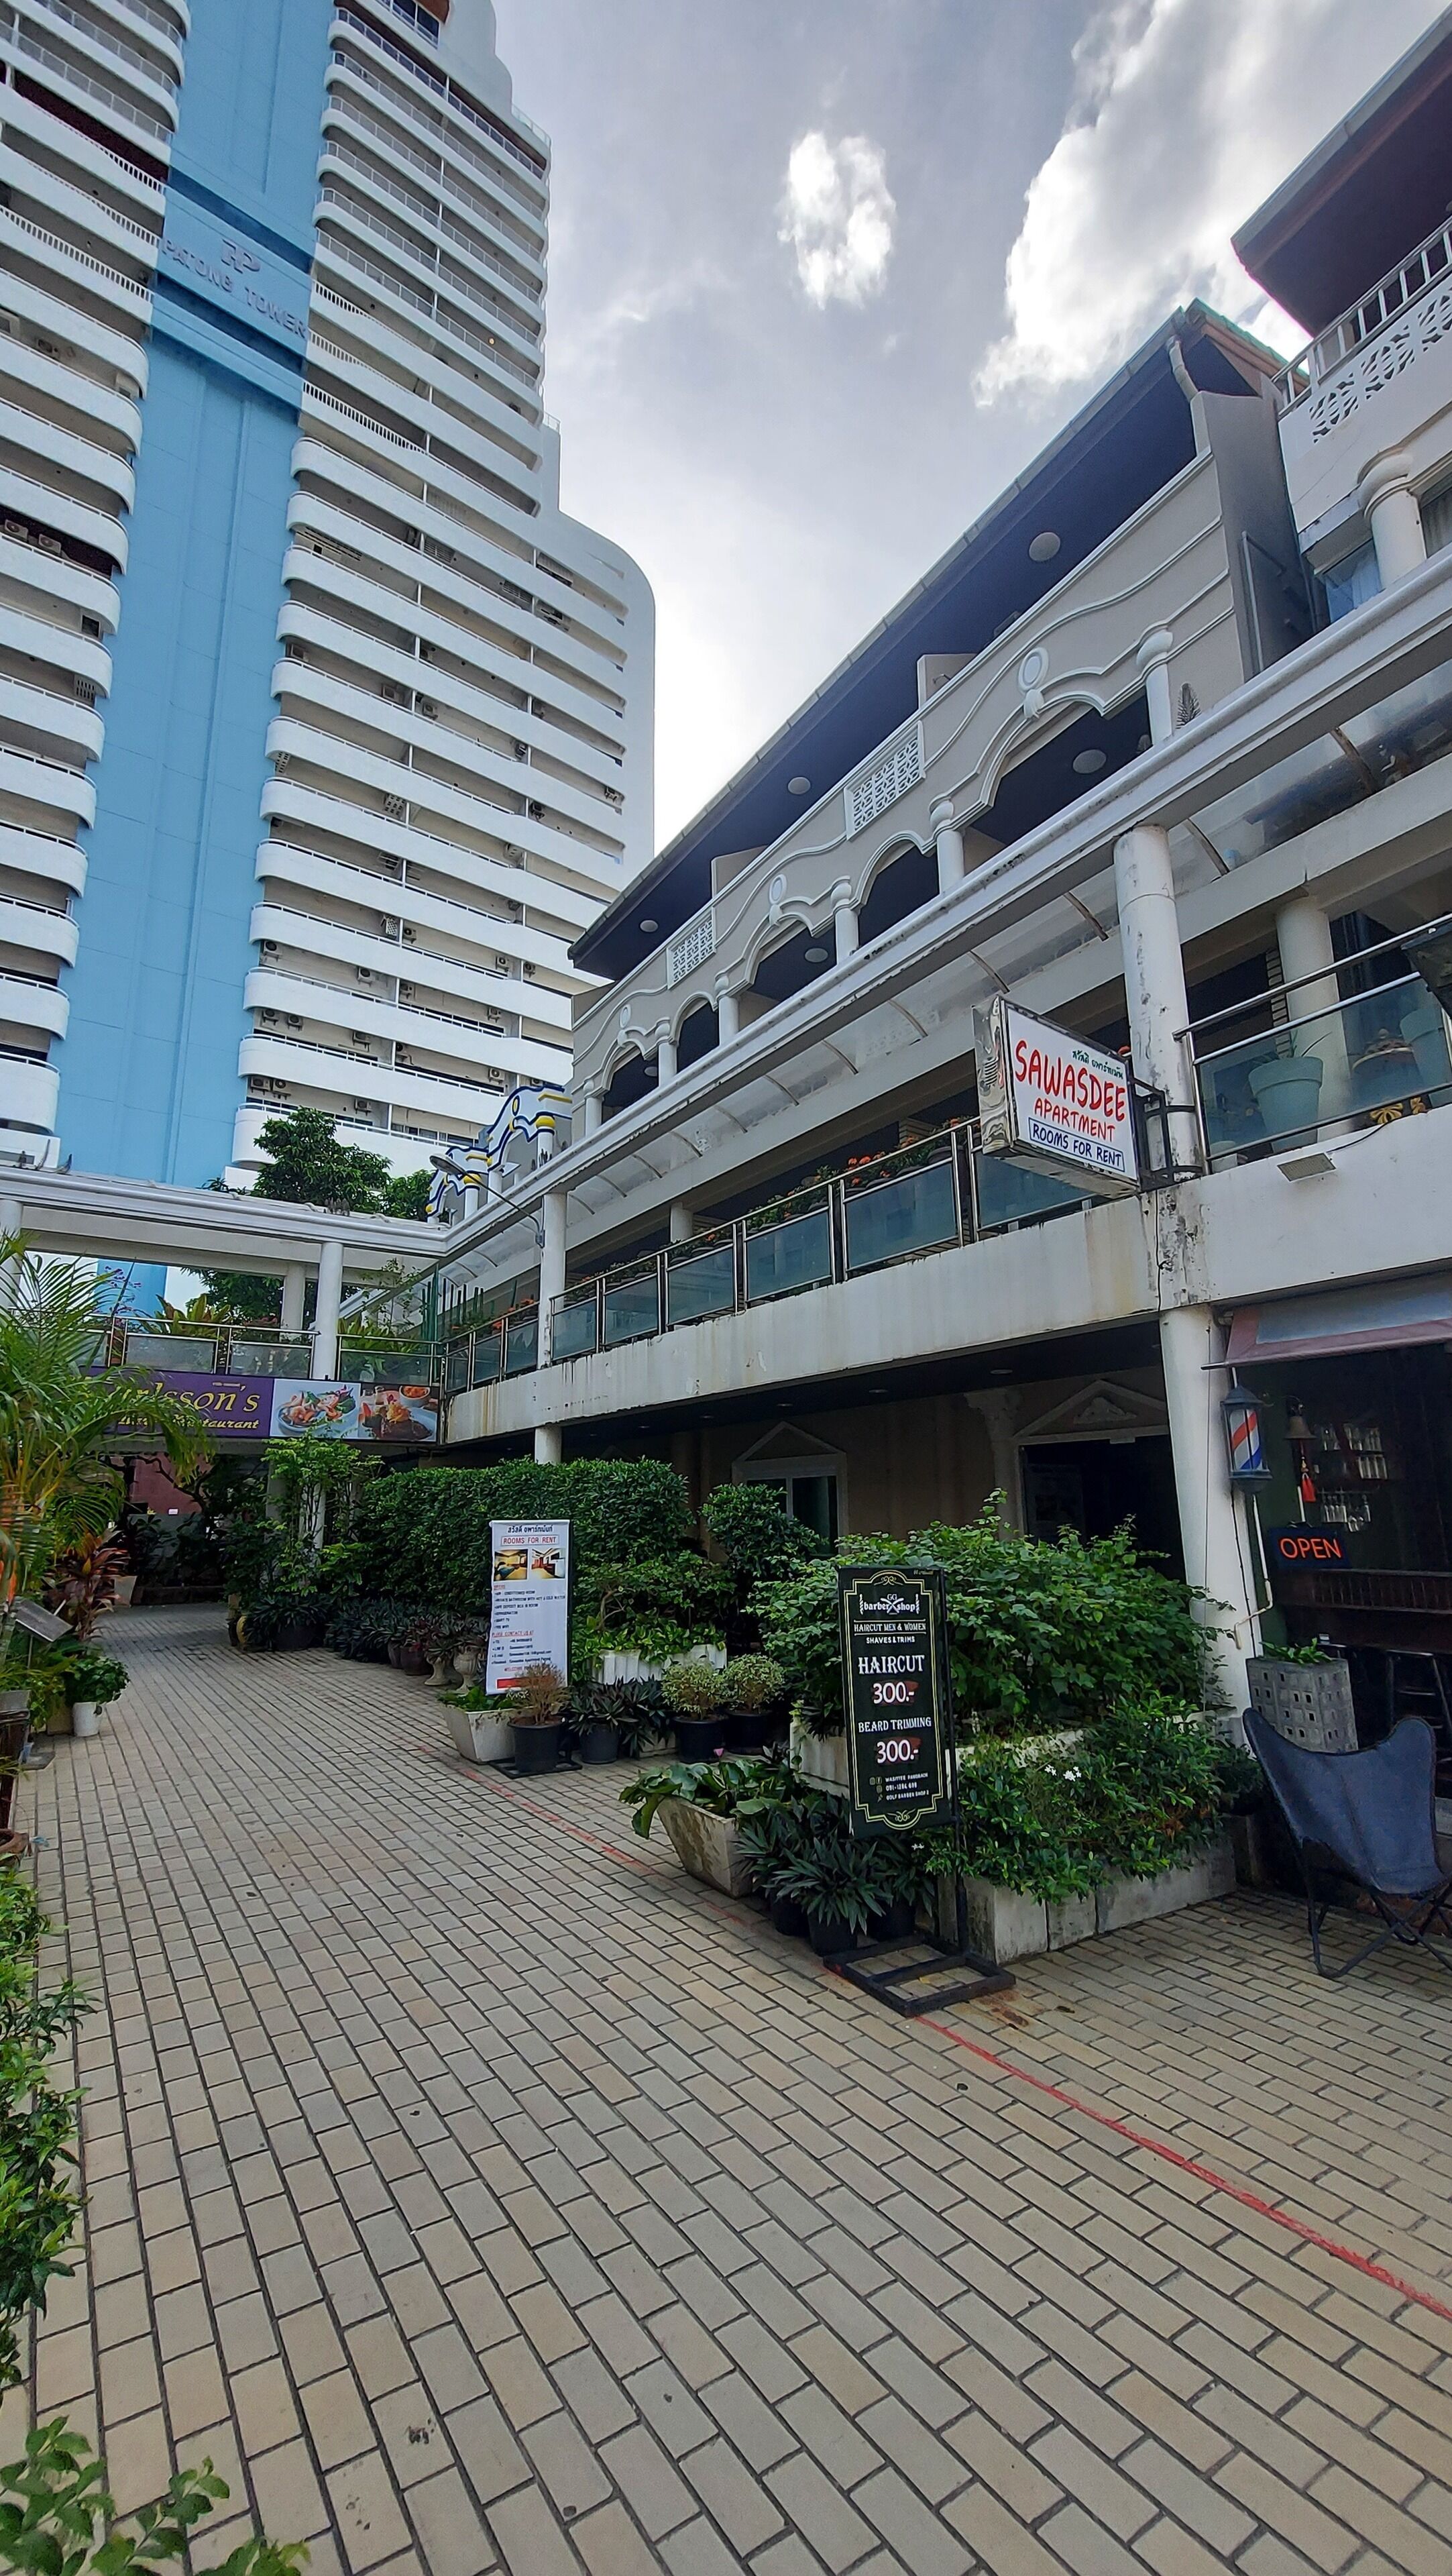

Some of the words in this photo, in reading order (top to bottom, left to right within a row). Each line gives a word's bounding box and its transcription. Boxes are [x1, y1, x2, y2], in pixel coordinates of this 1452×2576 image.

[162, 238, 233, 294] PATONG
[244, 286, 306, 339] TOWER
[1015, 1040, 1125, 1122] SAWASDEE
[1034, 1097, 1116, 1143] APARTMENT
[1032, 1123, 1069, 1150] ROOMS
[1073, 1139, 1093, 1159] FOR
[1097, 1149, 1122, 1168] RENT
[1280, 1538, 1342, 1559] OPEN
[864, 1601, 889, 1610] barber
[897, 1603, 916, 1612] shop
[854, 1623, 883, 1632] HAIRCUT
[904, 1622, 926, 1631] WOMEN
[858, 1654, 925, 1675] HAIRCUT
[858, 1720, 889, 1733] BEARD
[891, 1717, 932, 1731] TRIMMING
